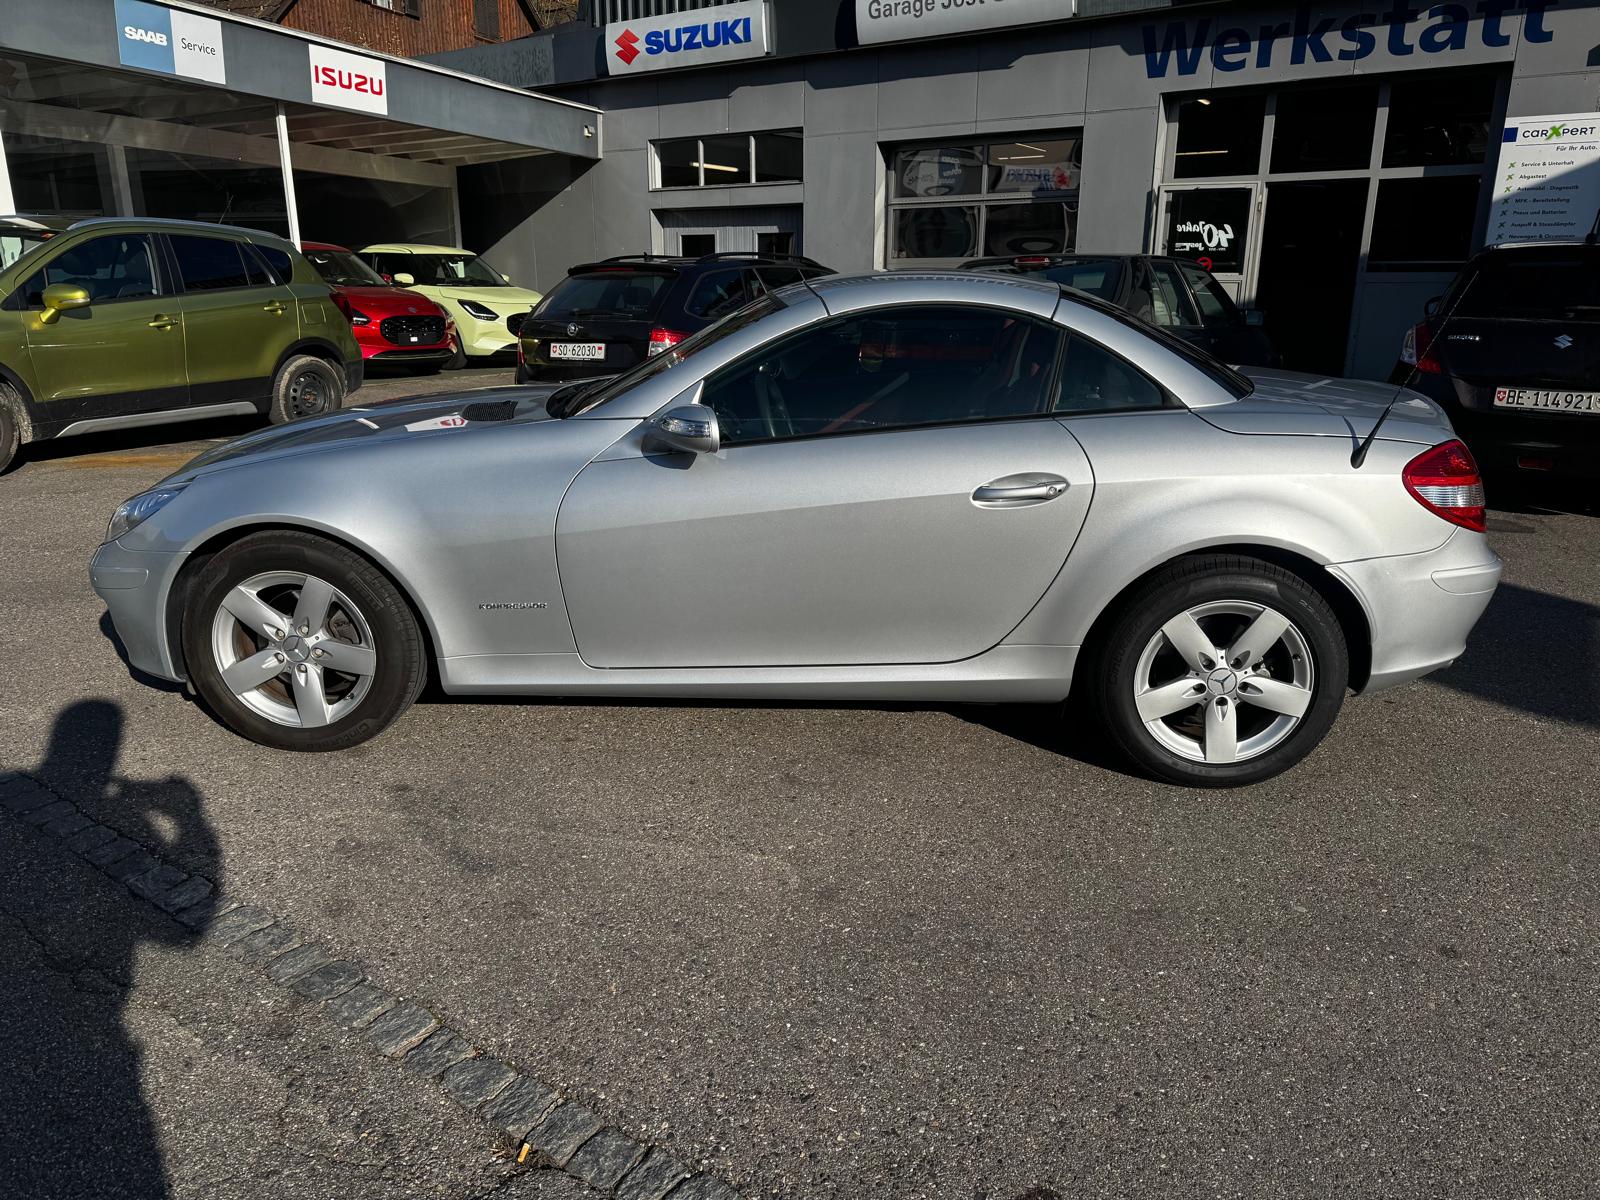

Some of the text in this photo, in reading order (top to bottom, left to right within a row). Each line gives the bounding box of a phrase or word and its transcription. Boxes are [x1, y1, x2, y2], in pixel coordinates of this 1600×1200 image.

[868, 0, 985, 19] Garage Jo
[124, 26, 168, 47] SAAB
[181, 38, 216, 57] Service
[645, 17, 752, 55] SUZUKI
[1142, 0, 1555, 79] Werkstatt
[314, 65, 383, 96] ISUZU
